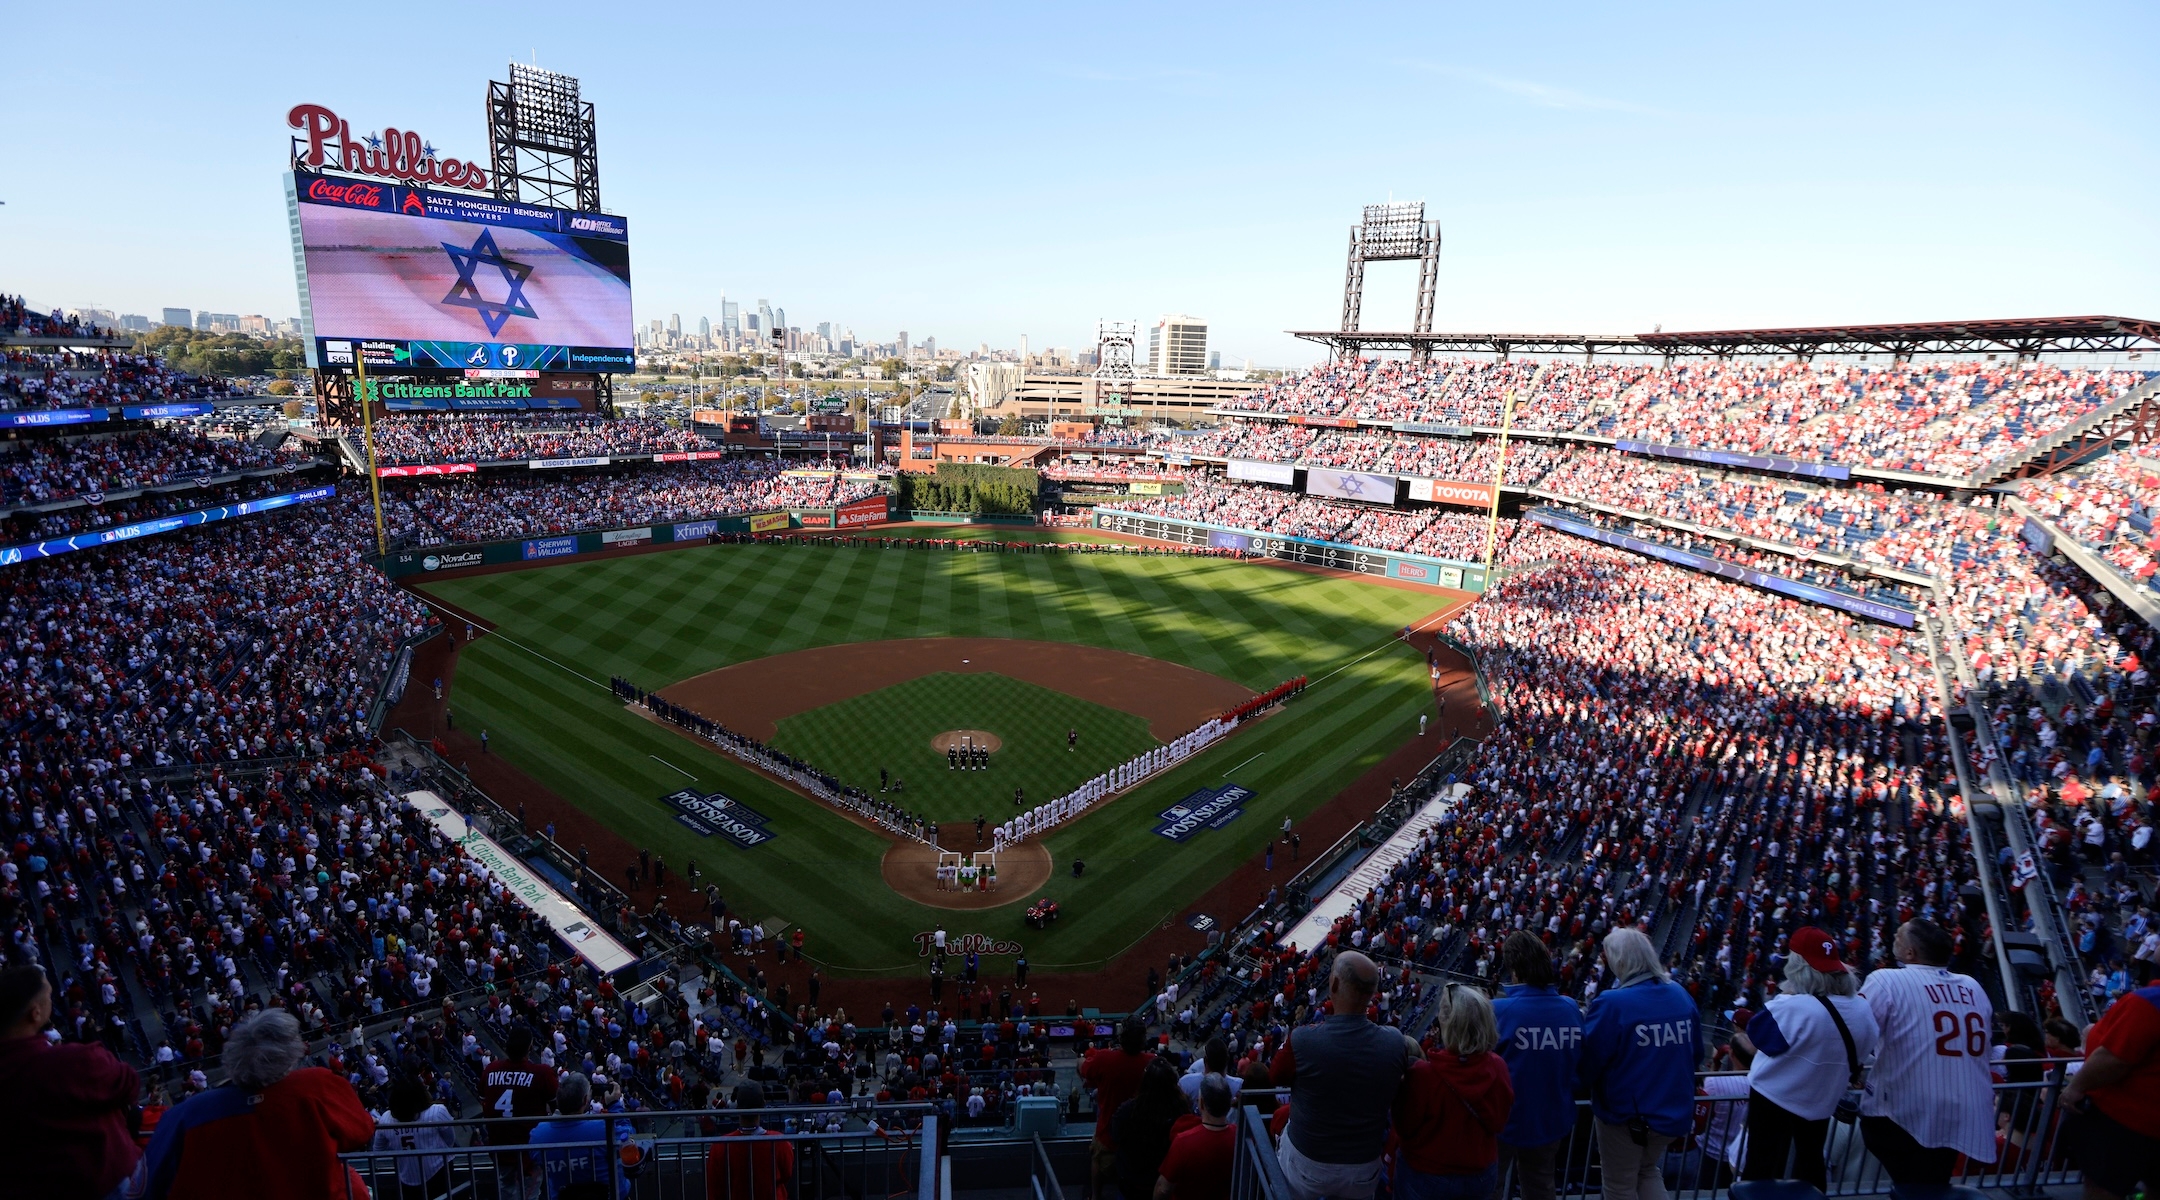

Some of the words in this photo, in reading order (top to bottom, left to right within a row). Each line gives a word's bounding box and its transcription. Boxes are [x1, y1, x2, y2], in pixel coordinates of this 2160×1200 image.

[287, 104, 488, 190] Phillies
[309, 178, 382, 207] Coca-Cola
[426, 196, 453, 207] SALTZ
[457, 200, 511, 214] MONGELUZZI
[513, 208, 554, 220] BENDESKY
[427, 206, 455, 215] TRIAL
[462, 210, 502, 221] LAWYERS
[361, 342, 396, 350] Building
[572, 354, 624, 364] Independence
[382, 383, 451, 398] Citizens
[455, 384, 496, 398] Bank
[500, 384, 532, 398] Park
[27, 413, 50, 424] NLDS
[151, 407, 168, 416] NLDS
[1104, 416, 1123, 425] Park
[1305, 416, 1340, 425] McDonald's
[1404, 424, 1432, 432] LISCIO'S
[1433, 426, 1460, 434] BAKERY
[572, 458, 598, 466] BAKERY
[1245, 466, 1290, 479] LifeBrand
[300, 489, 327, 500] PHILLIES
[1435, 486, 1490, 501] TOYOTA
[801, 516, 831, 524] GIANT
[115, 526, 140, 540] NLDS
[676, 523, 715, 540] xfinity
[538, 538, 572, 548] SHERWIN
[617, 540, 639, 548] LAGER
[1219, 538, 1237, 547] NLDS
[440, 552, 482, 564] NovaCare
[1401, 565, 1424, 577] HERR'S
[1844, 599, 1896, 620] PHILLIES
[669, 791, 766, 845] POSTSEASON
[728, 806, 762, 826] 2023
[1161, 786, 1249, 839] POSTSEASON
[1339, 843, 1410, 899] PHILADELPHIA
[1400, 812, 1441, 844] PHILLIES
[470, 842, 504, 870] Citizens
[500, 867, 525, 888] Bank
[521, 884, 547, 904] Park
[1925, 984, 1975, 1006] UTLEY
[1514, 1026, 1581, 1050] STAFF
[1635, 1018, 1692, 1047] STAFF
[1933, 1010, 1986, 1057] 26
[487, 1071, 534, 1087] DYKSTRA
[494, 1089, 514, 1117] 4
[401, 1135, 416, 1150] 5
